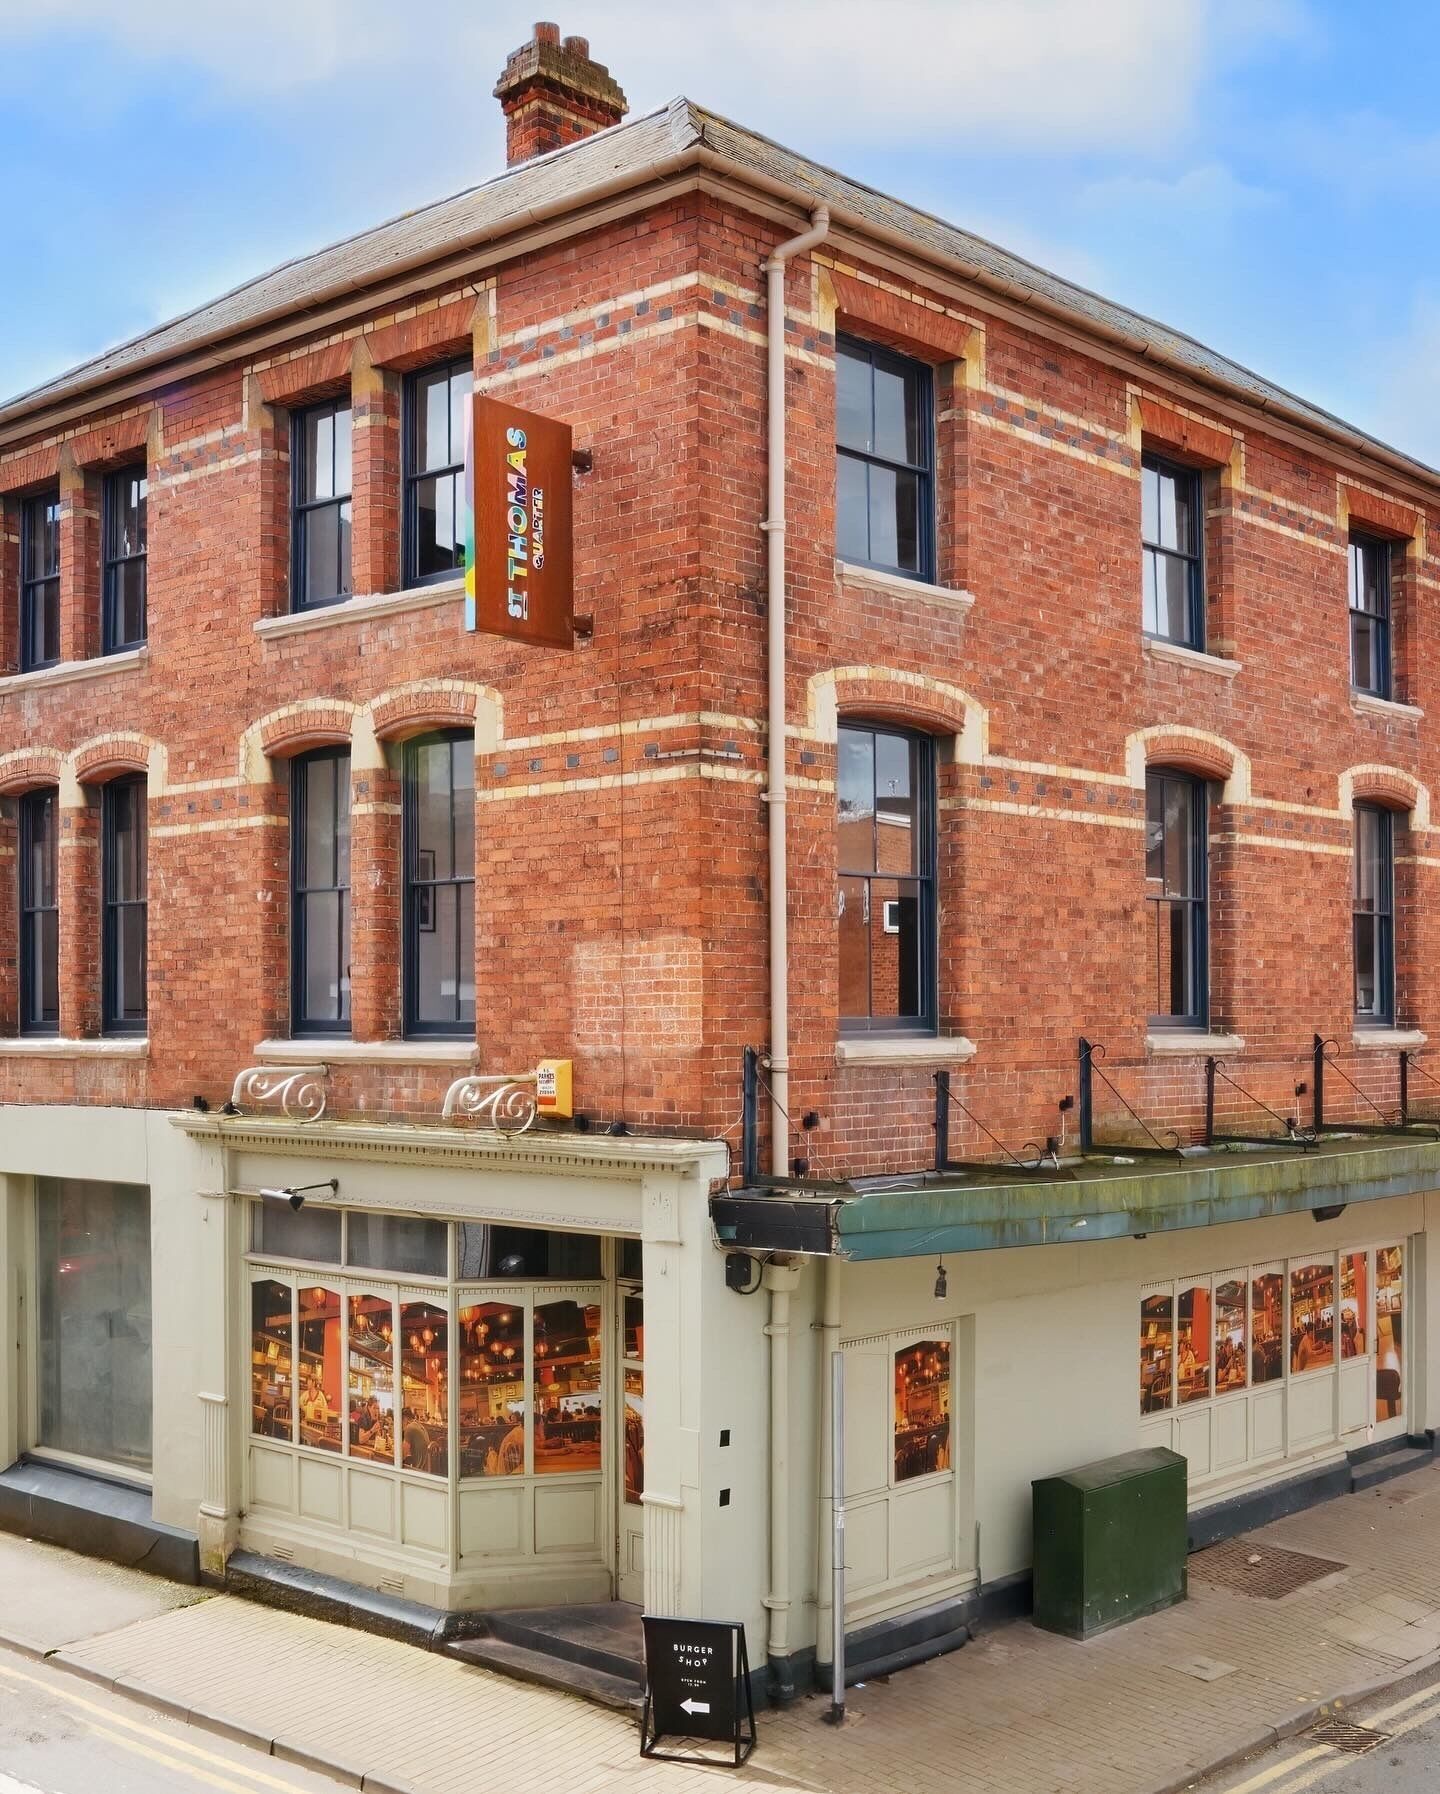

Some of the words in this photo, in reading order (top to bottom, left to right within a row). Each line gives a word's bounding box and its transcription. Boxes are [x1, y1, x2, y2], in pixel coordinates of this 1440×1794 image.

[506, 427, 528, 581] THOMAS
[532, 487, 545, 570] QUARTER
[508, 588, 524, 620] ST
[673, 1644, 713, 1655] BURGER
[678, 1655, 708, 1668] SHOP
